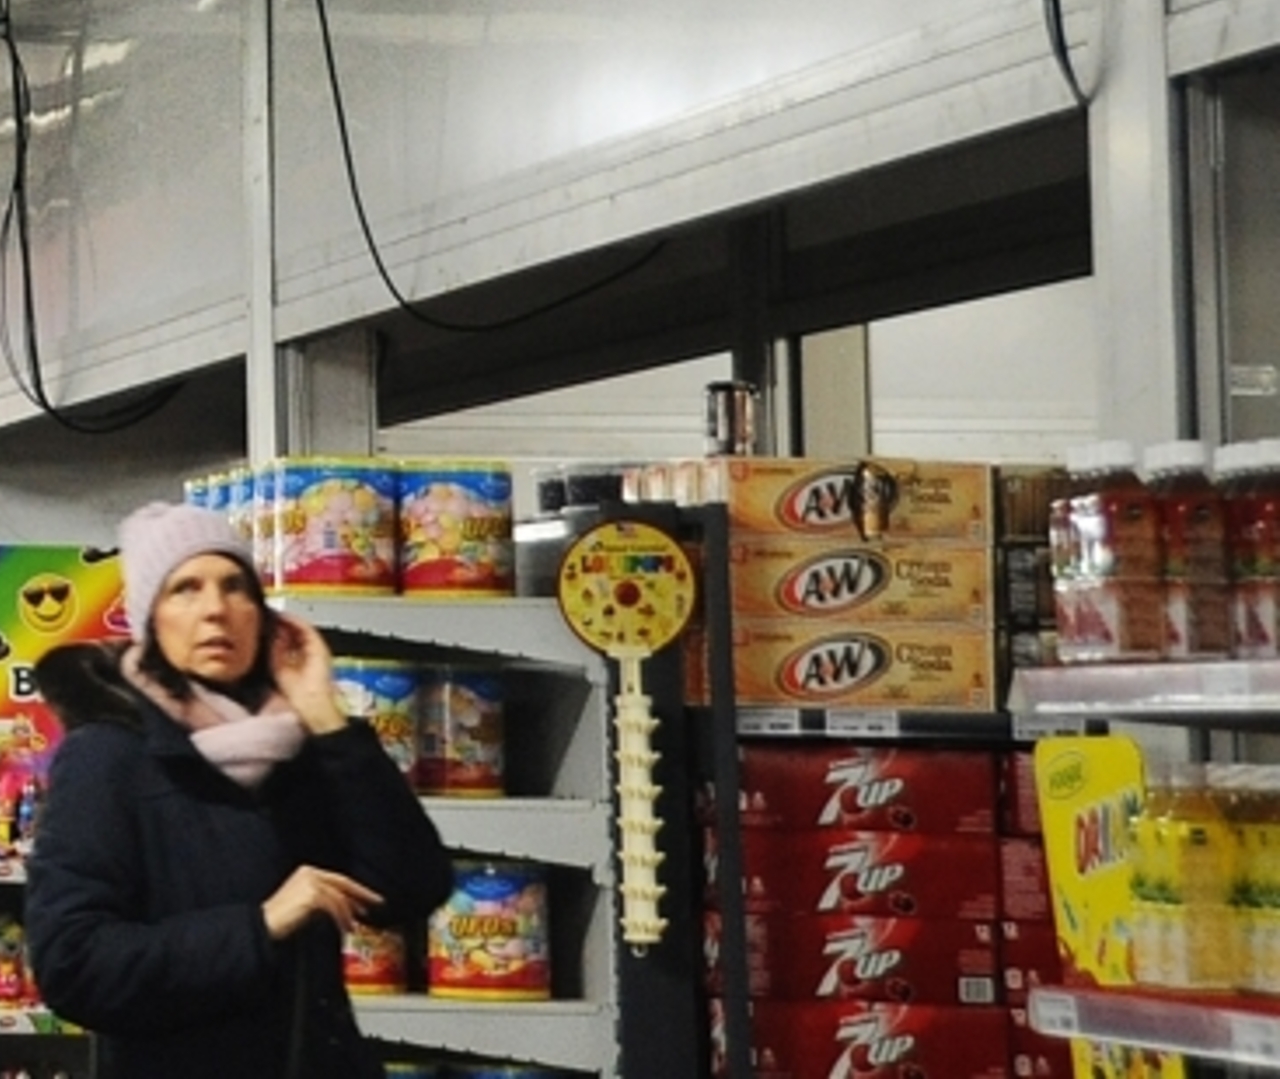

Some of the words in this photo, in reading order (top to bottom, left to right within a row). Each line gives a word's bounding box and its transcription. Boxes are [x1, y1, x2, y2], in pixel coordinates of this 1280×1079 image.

[817, 754, 904, 825] 7UP
[817, 838, 904, 911] 7UP
[815, 925, 901, 996] 7UP
[827, 1010, 915, 1079] 7UP
